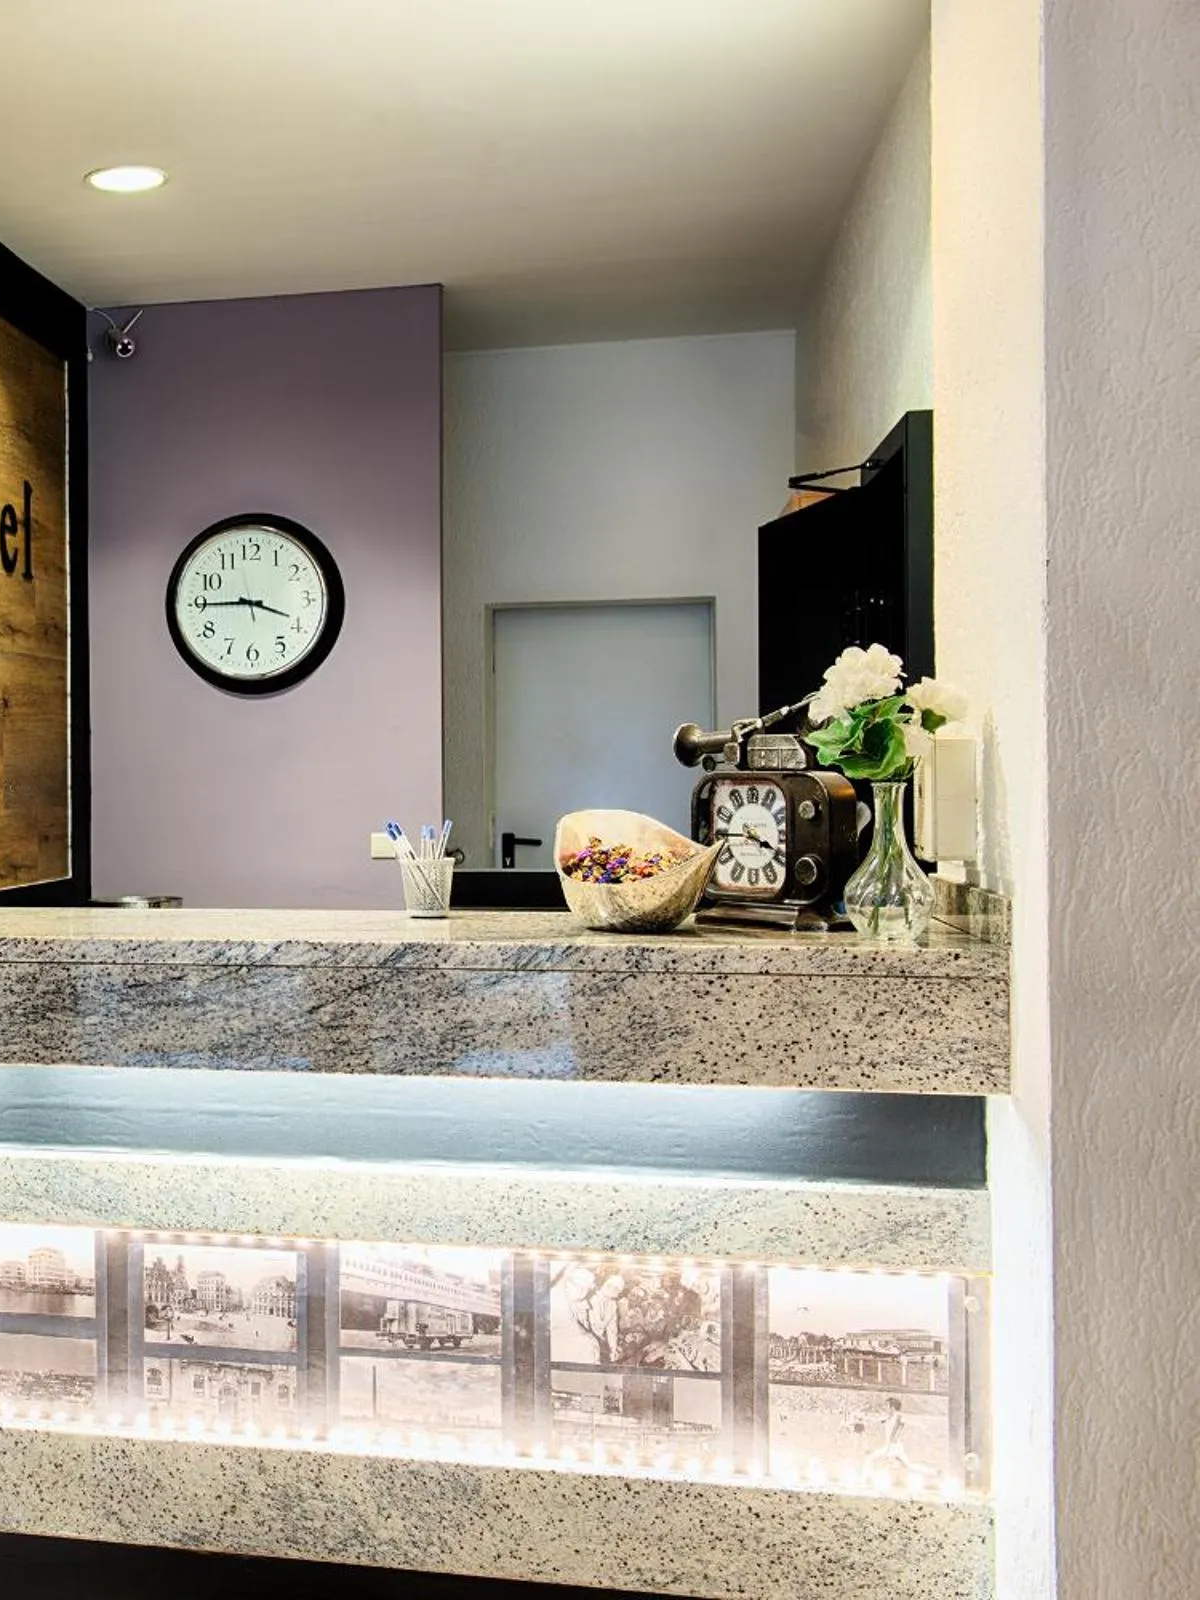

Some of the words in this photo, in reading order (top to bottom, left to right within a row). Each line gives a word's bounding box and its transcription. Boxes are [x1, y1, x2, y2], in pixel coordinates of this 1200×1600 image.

[221, 552, 235, 570] 11
[241, 543, 261, 561] 12
[202, 573, 222, 591] 10
[288, 564, 301, 582] 2
[194, 595, 207, 614] 9
[301, 590, 312, 609] 3
[202, 620, 216, 639] 8
[291, 616, 303, 634] 4
[224, 637, 236, 655] 7
[246, 643, 260, 662] 6
[275, 636, 286, 654] 5
